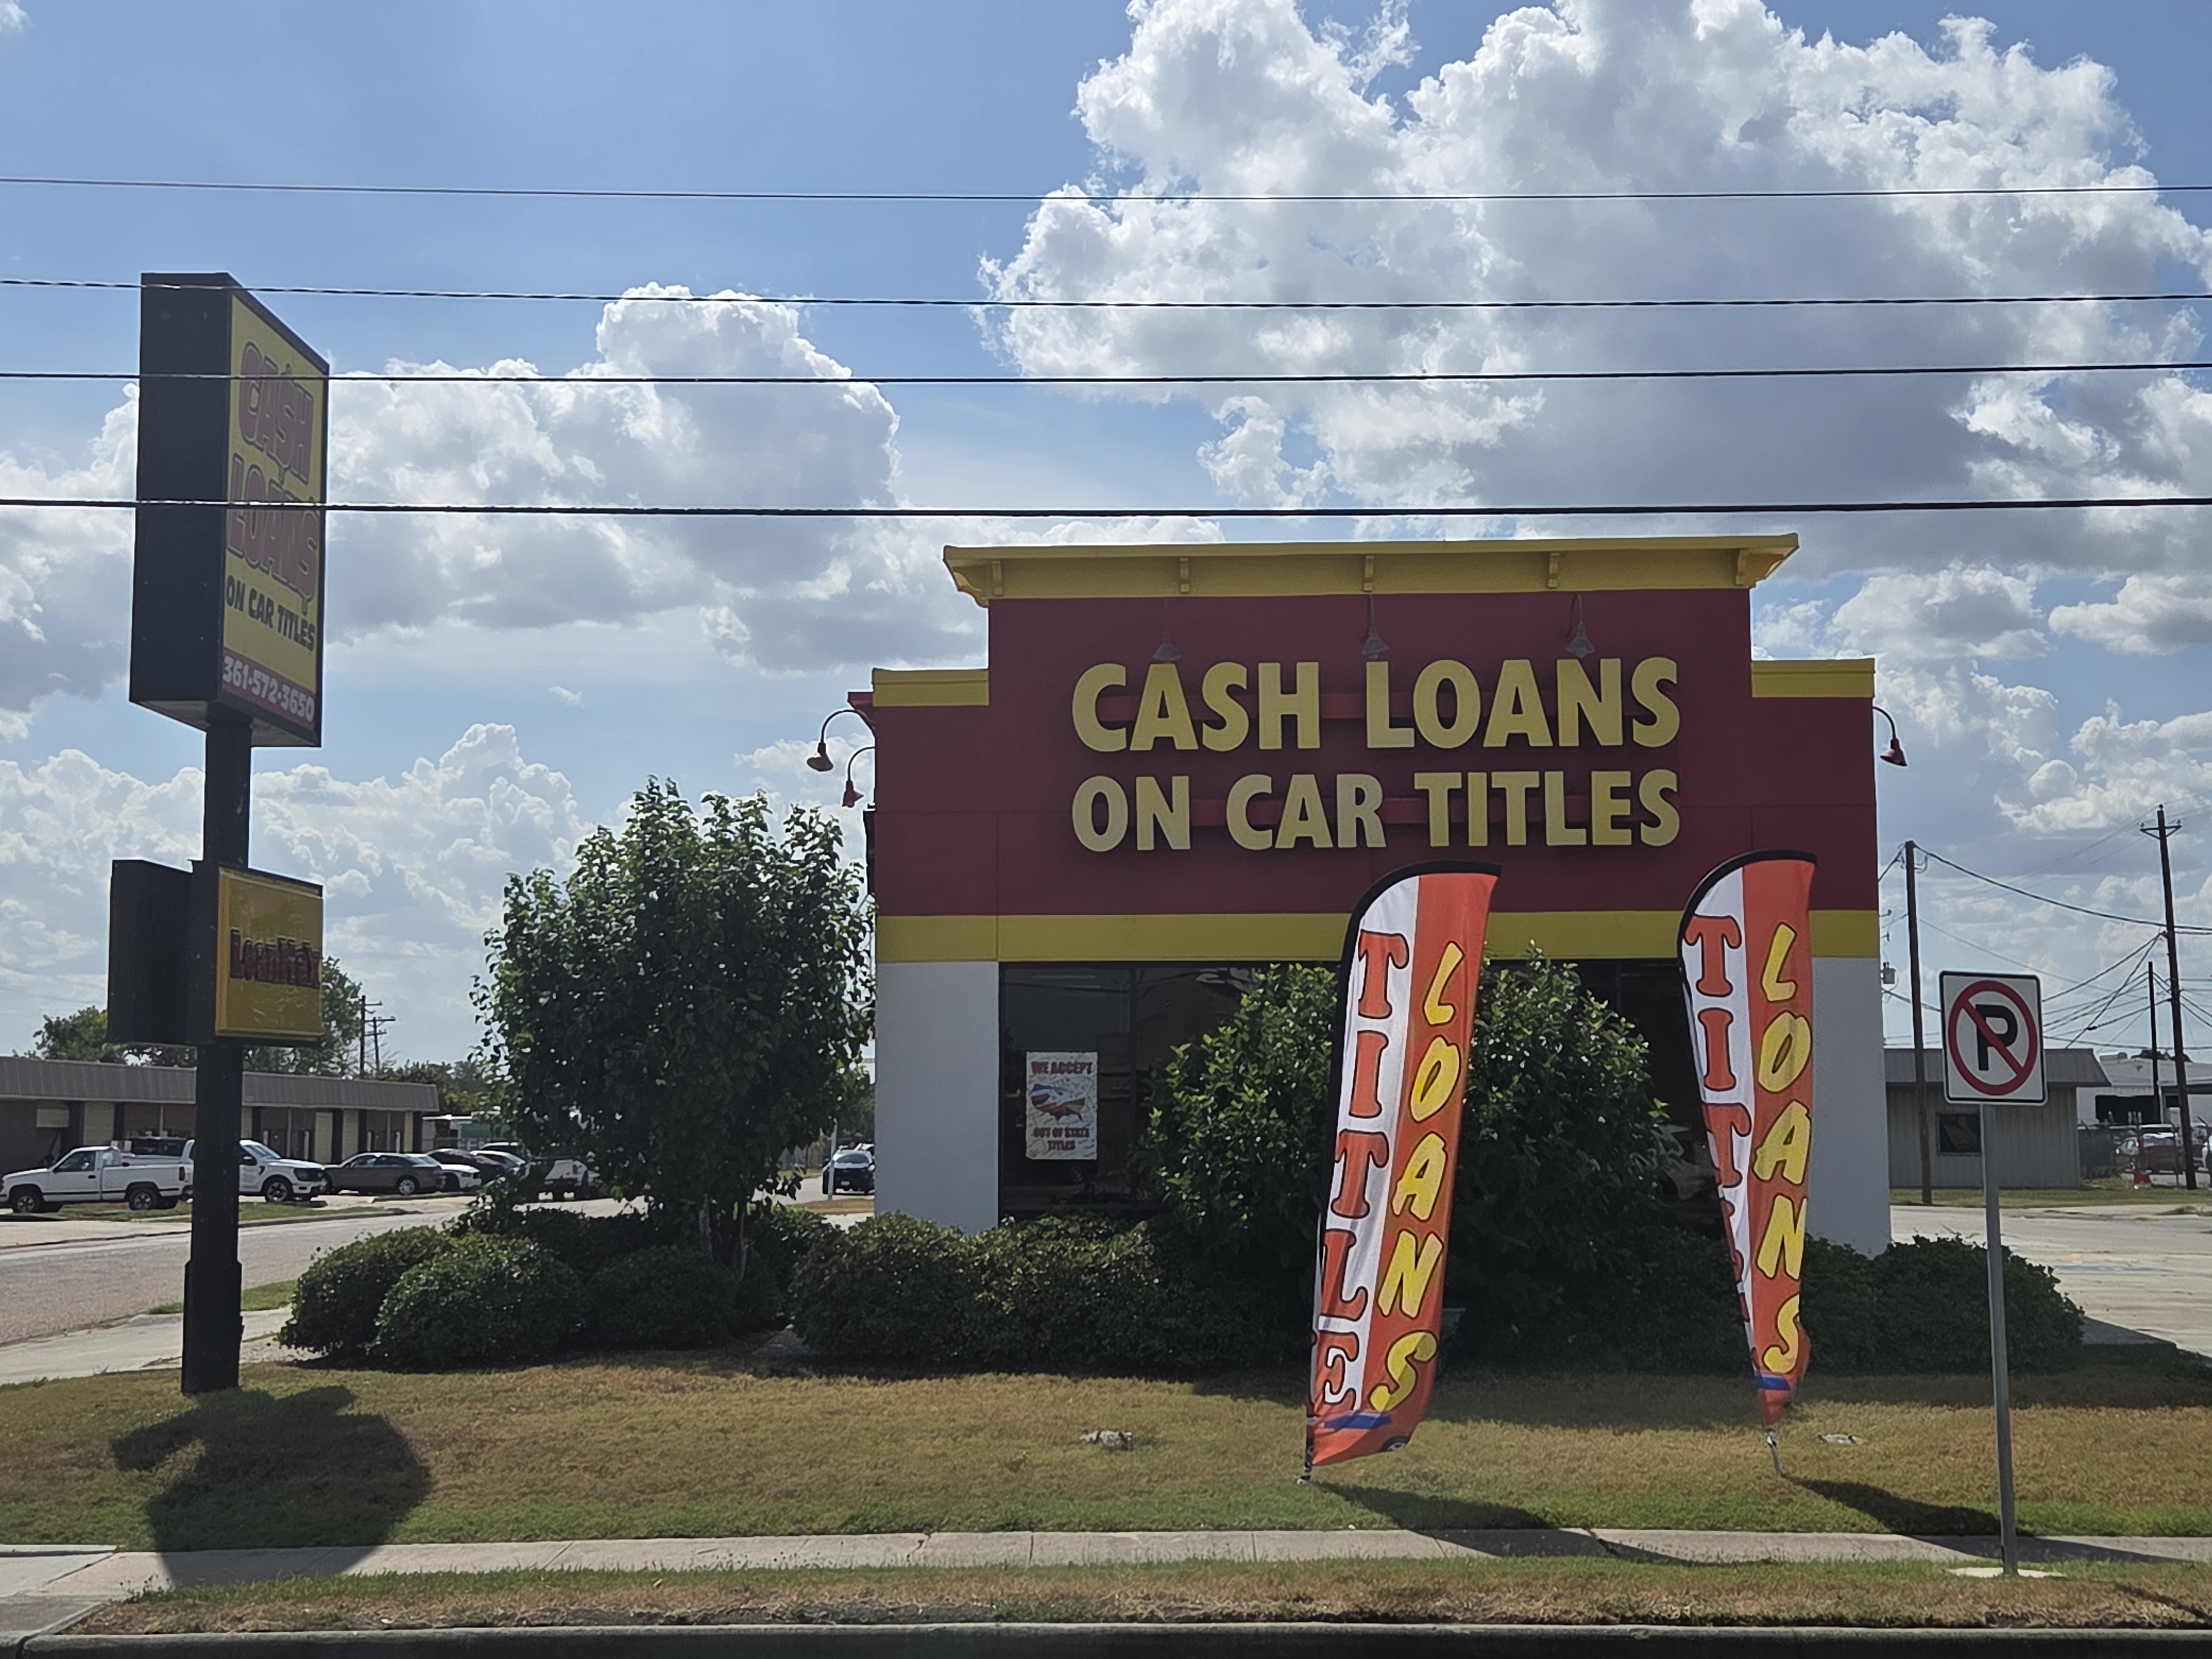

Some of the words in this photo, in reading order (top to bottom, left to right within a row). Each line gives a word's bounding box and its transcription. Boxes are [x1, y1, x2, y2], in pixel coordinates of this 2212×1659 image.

[226, 575, 246, 612] ON
[249, 587, 274, 629] CAR
[278, 604, 315, 652] TITLES
[1072, 661, 1321, 753] CASH
[1366, 656, 1680, 749] LOANS
[1072, 775, 1191, 852] ON
[1225, 773, 1387, 851] CAR
[1413, 769, 1680, 847] TITLES
[1031, 1061, 1049, 1074] WE
[1051, 1061, 1093, 1074] ACCEPT
[1975, 1004, 2018, 1071] P
[1368, 940, 1464, 1412] LOANS
[1752, 922, 1812, 1375] LOANS
